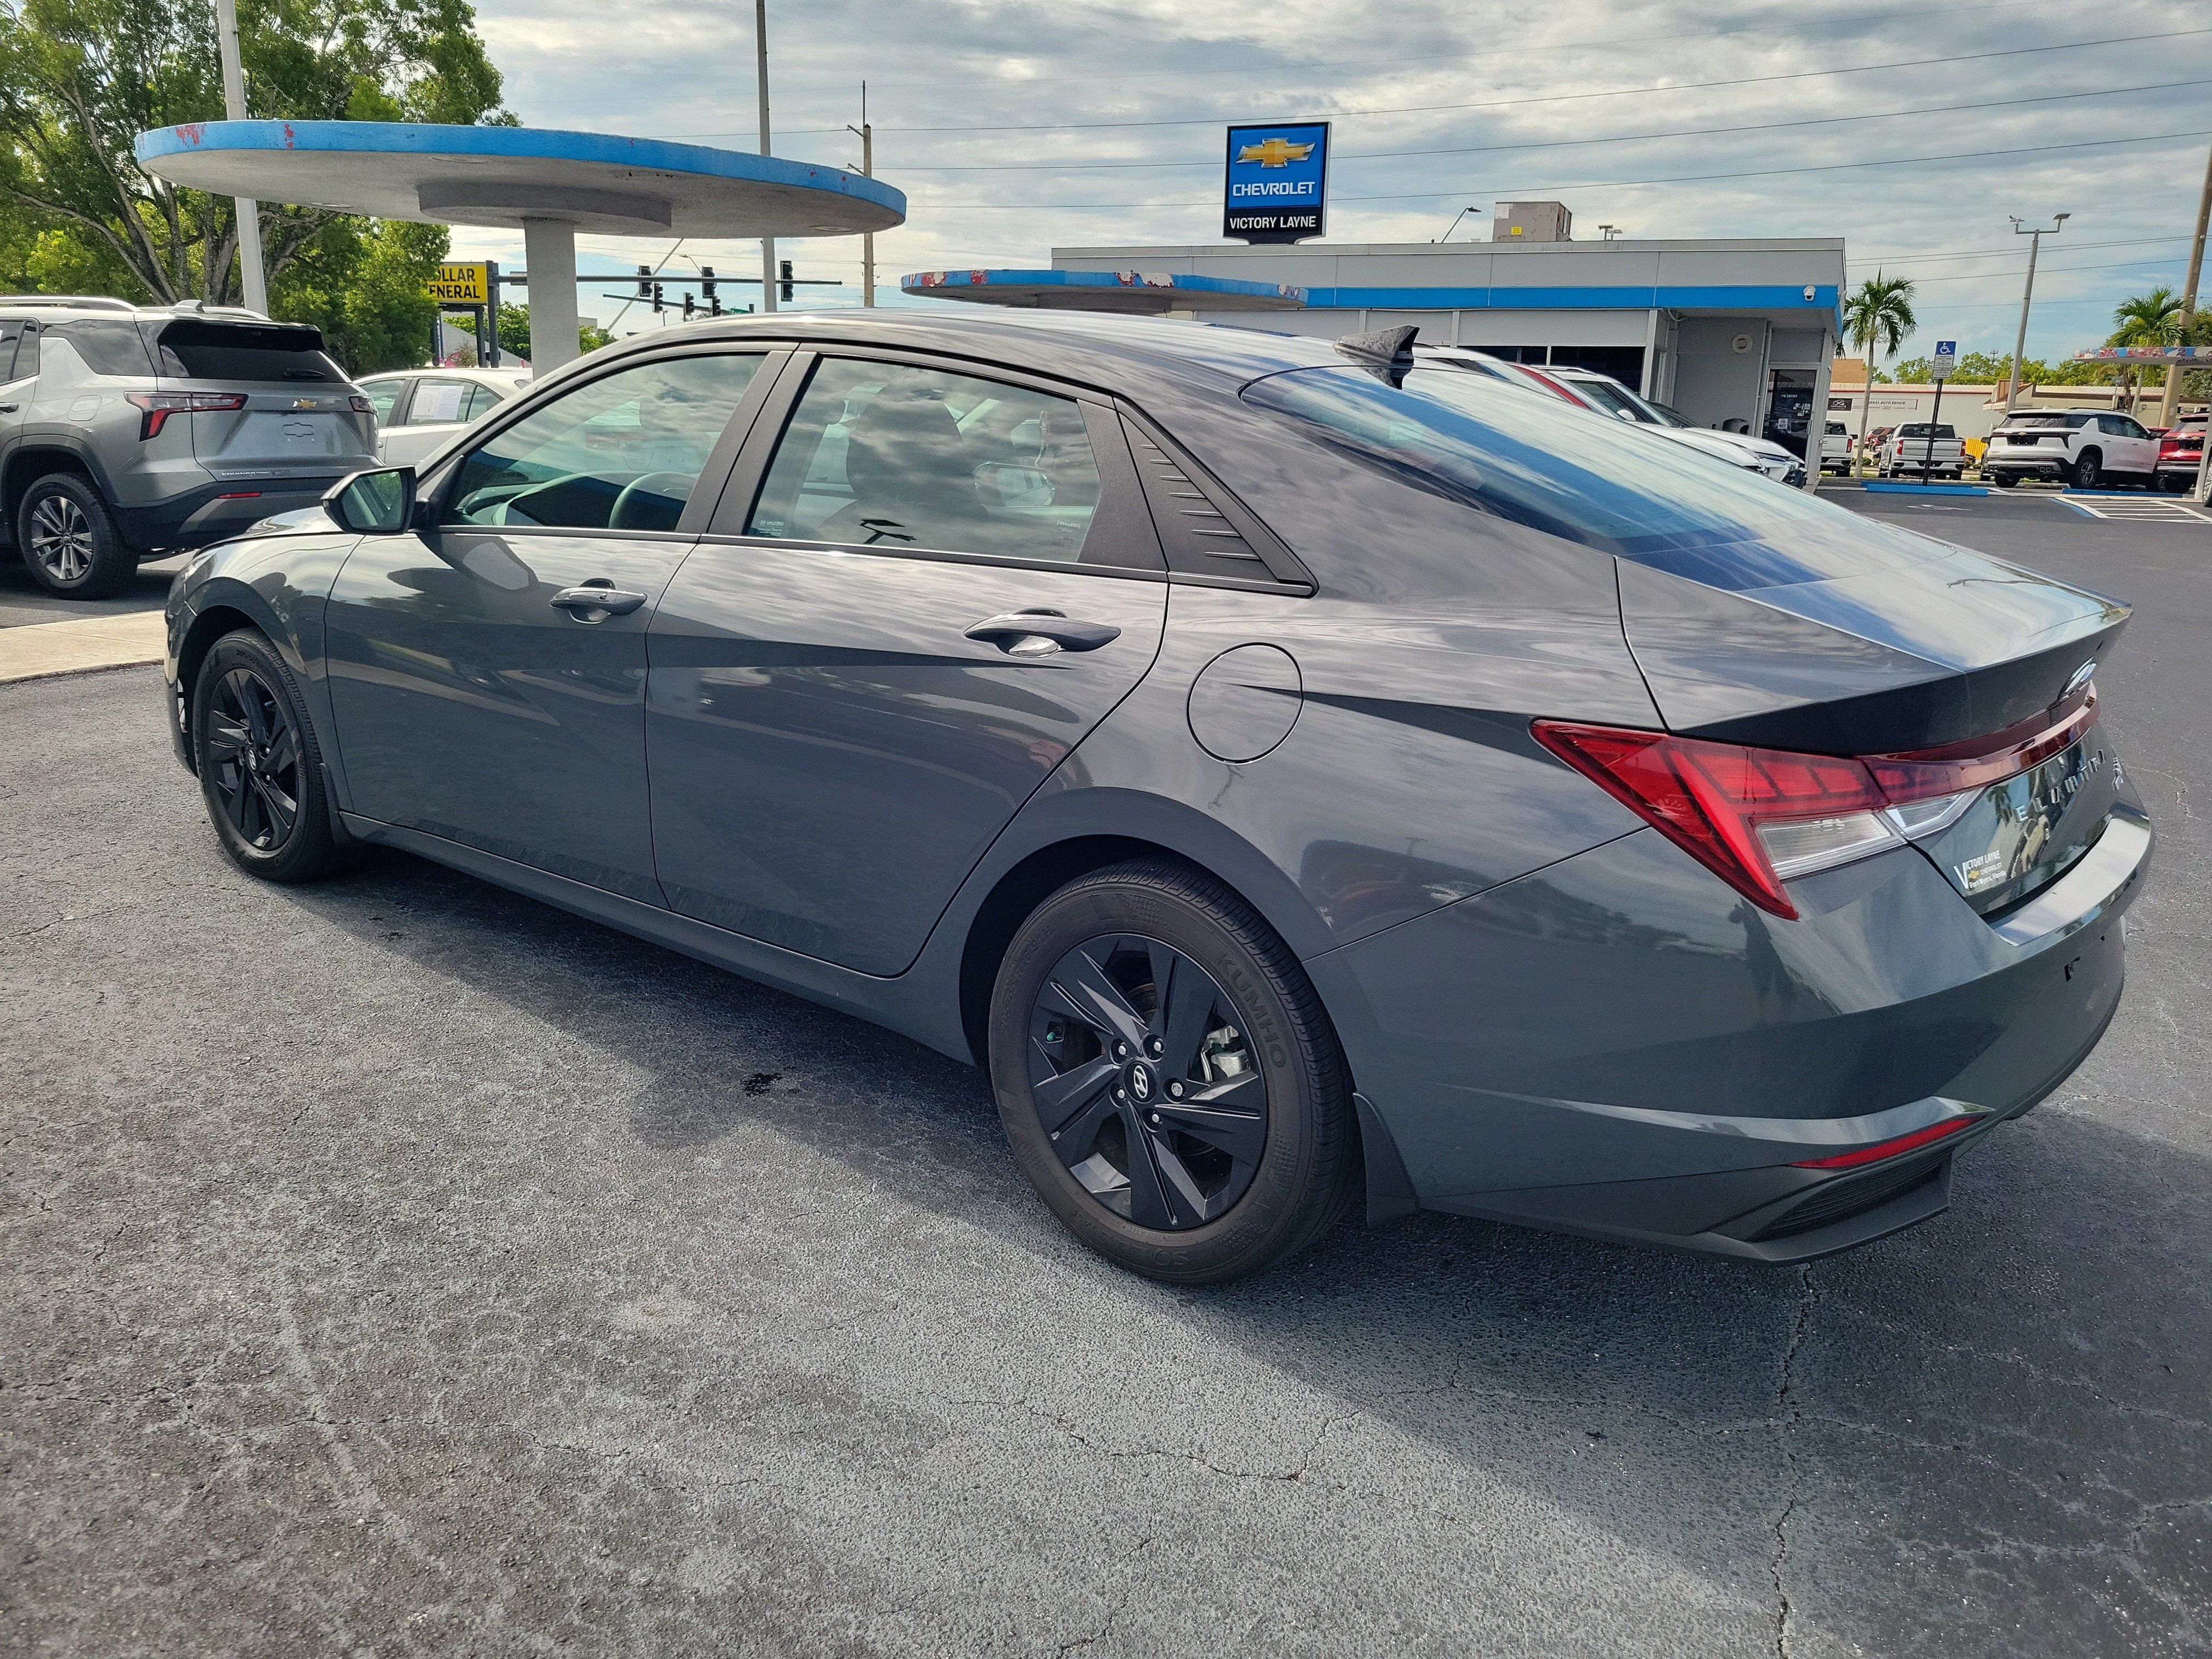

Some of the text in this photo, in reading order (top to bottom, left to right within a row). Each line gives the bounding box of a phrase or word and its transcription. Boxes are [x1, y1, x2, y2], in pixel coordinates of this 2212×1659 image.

[1232, 182, 1315, 196] CHEVROLET
[1229, 216, 1316, 229] VICTORY LAYNE
[438, 268, 476, 282] LLAR
[429, 284, 481, 298] ENERAL
[1953, 850, 2001, 889] VICTORY LAYNE
[1209, 953, 1286, 1068] KUMHO
